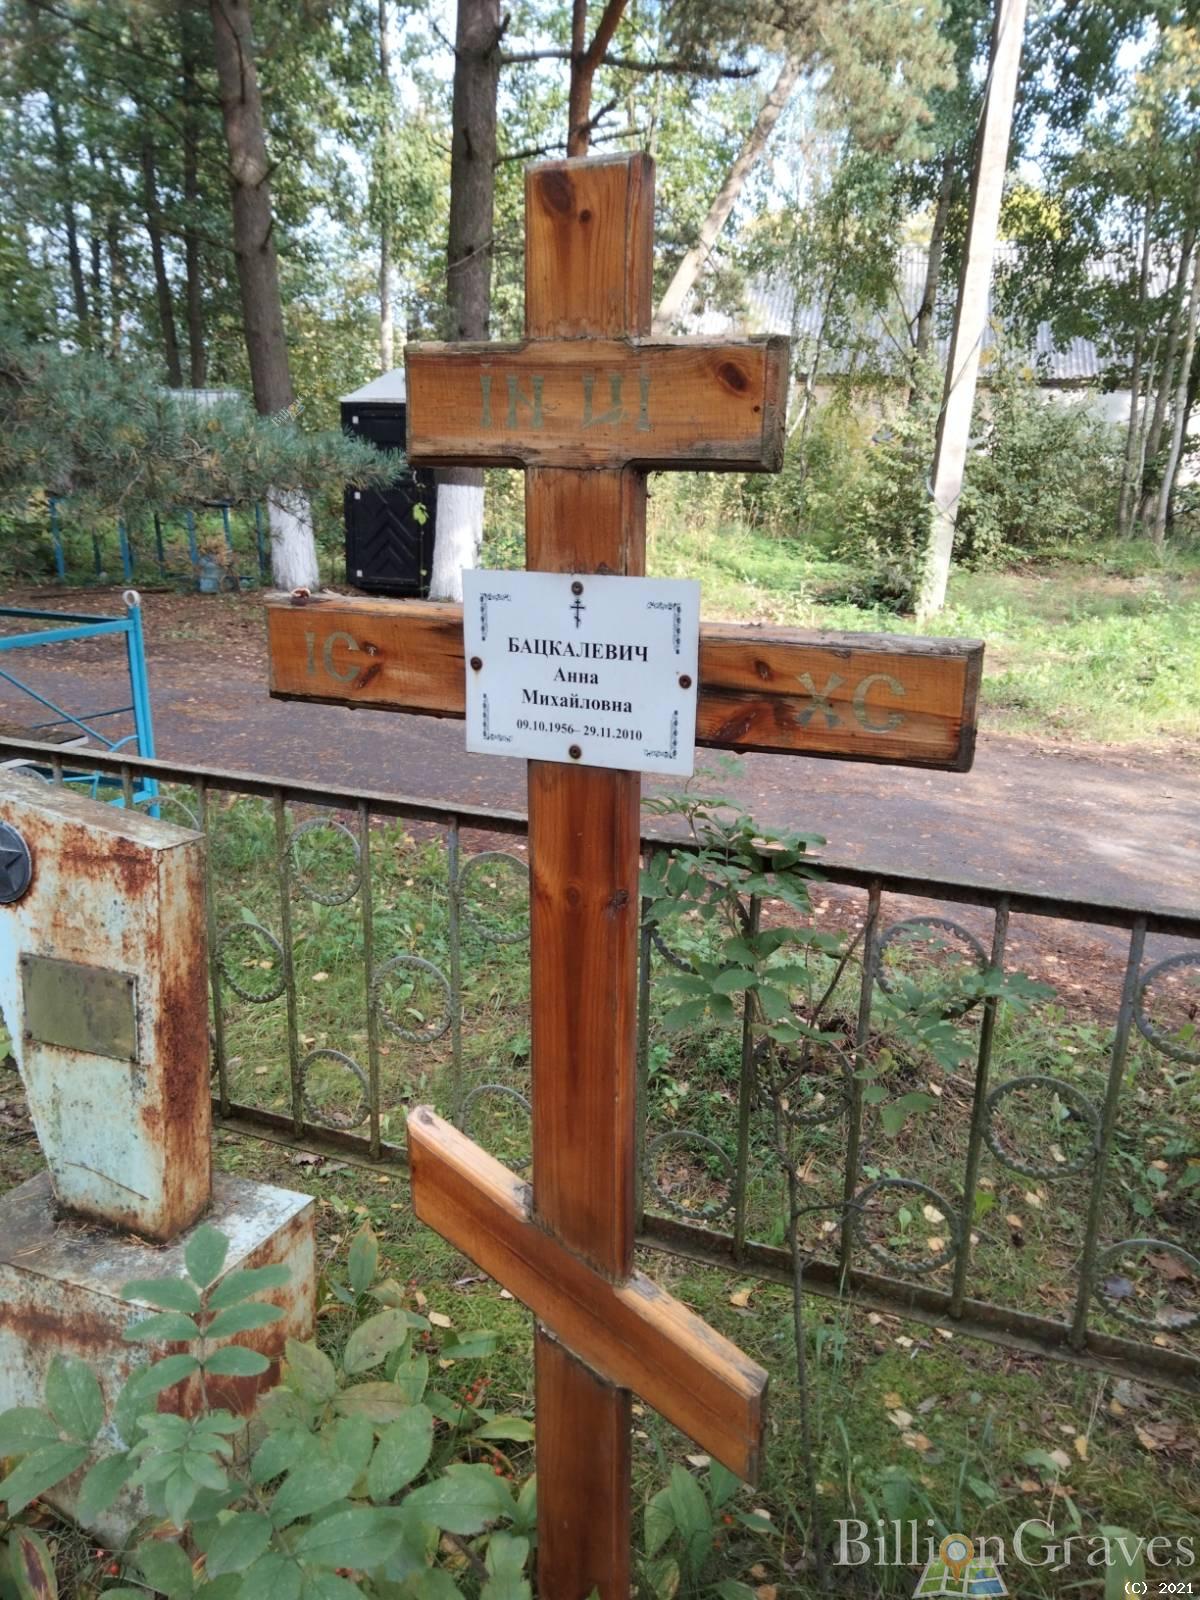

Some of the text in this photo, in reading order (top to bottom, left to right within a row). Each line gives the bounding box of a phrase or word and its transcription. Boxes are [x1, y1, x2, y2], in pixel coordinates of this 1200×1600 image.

[508, 636, 649, 662] БАЦКАЛЕВИЧ
[553, 667, 599, 685] Анна
[521, 688, 633, 713] Михайловна
[583, 724, 643, 741] 29.11.2010
